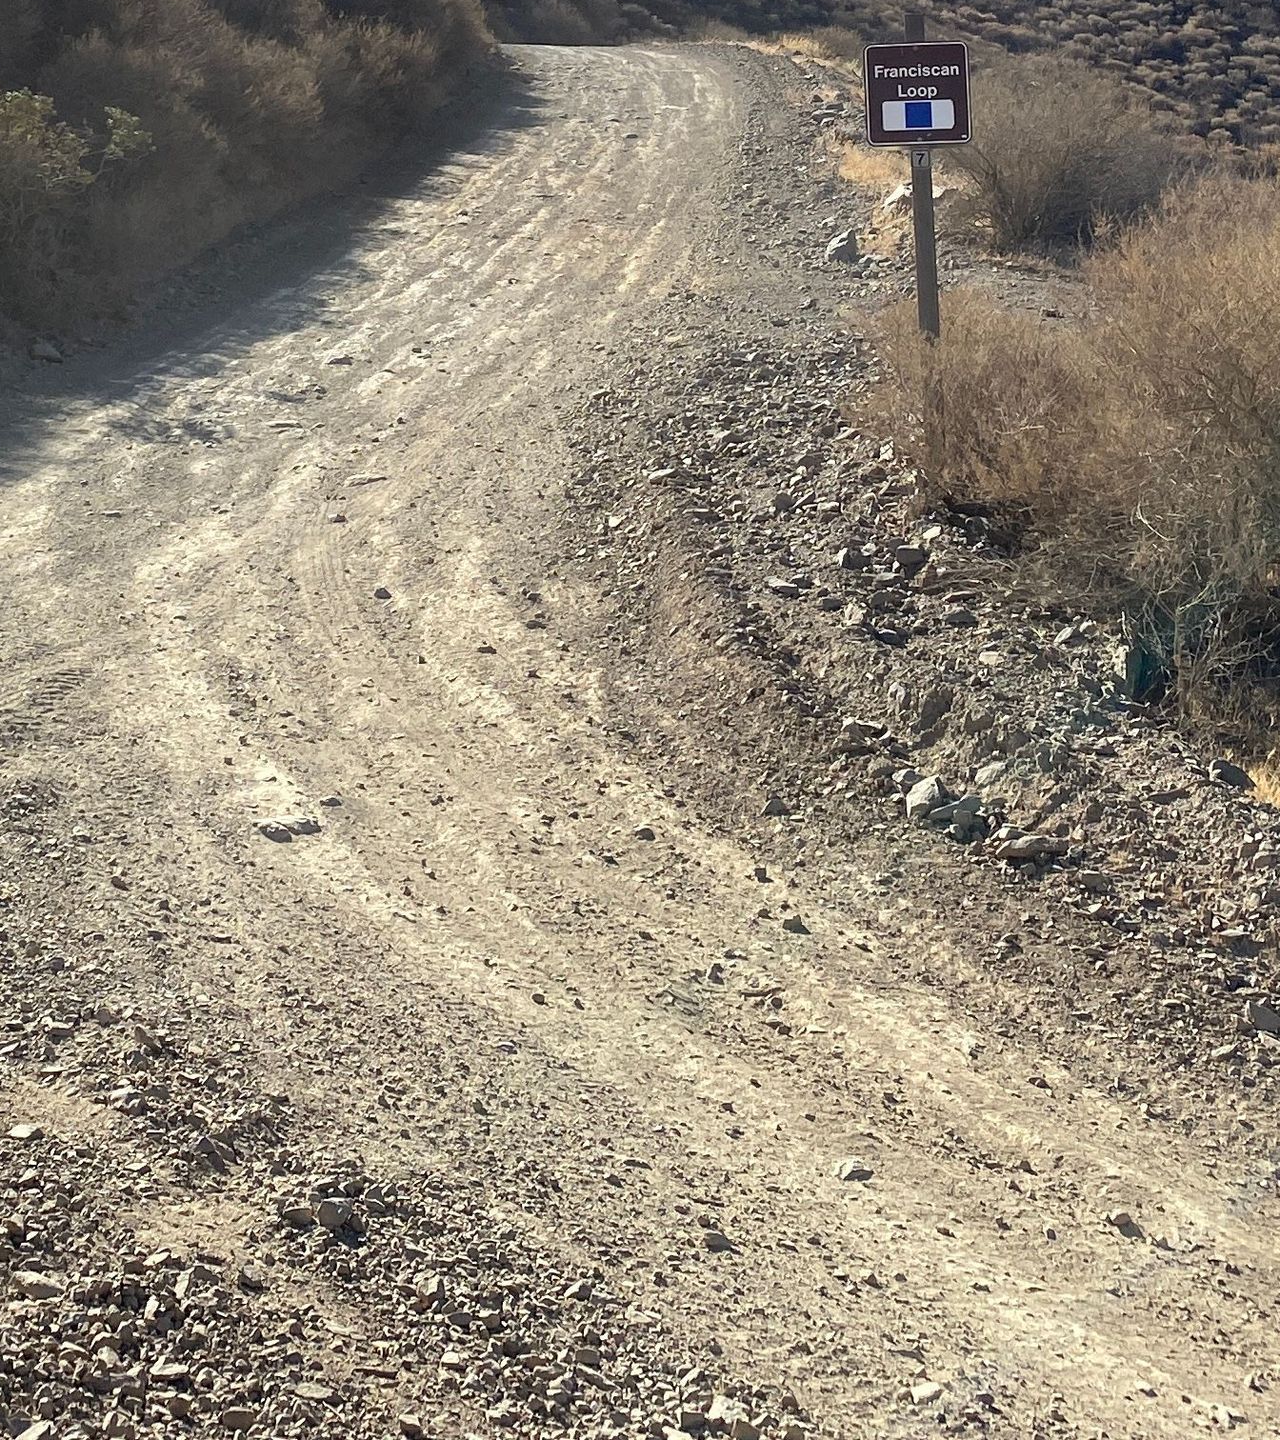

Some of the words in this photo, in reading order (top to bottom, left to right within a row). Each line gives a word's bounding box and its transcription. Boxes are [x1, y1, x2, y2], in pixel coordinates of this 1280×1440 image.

[874, 63, 959, 78] Franciscan
[897, 84, 938, 99] Loop
[916, 153, 925, 165] 7
